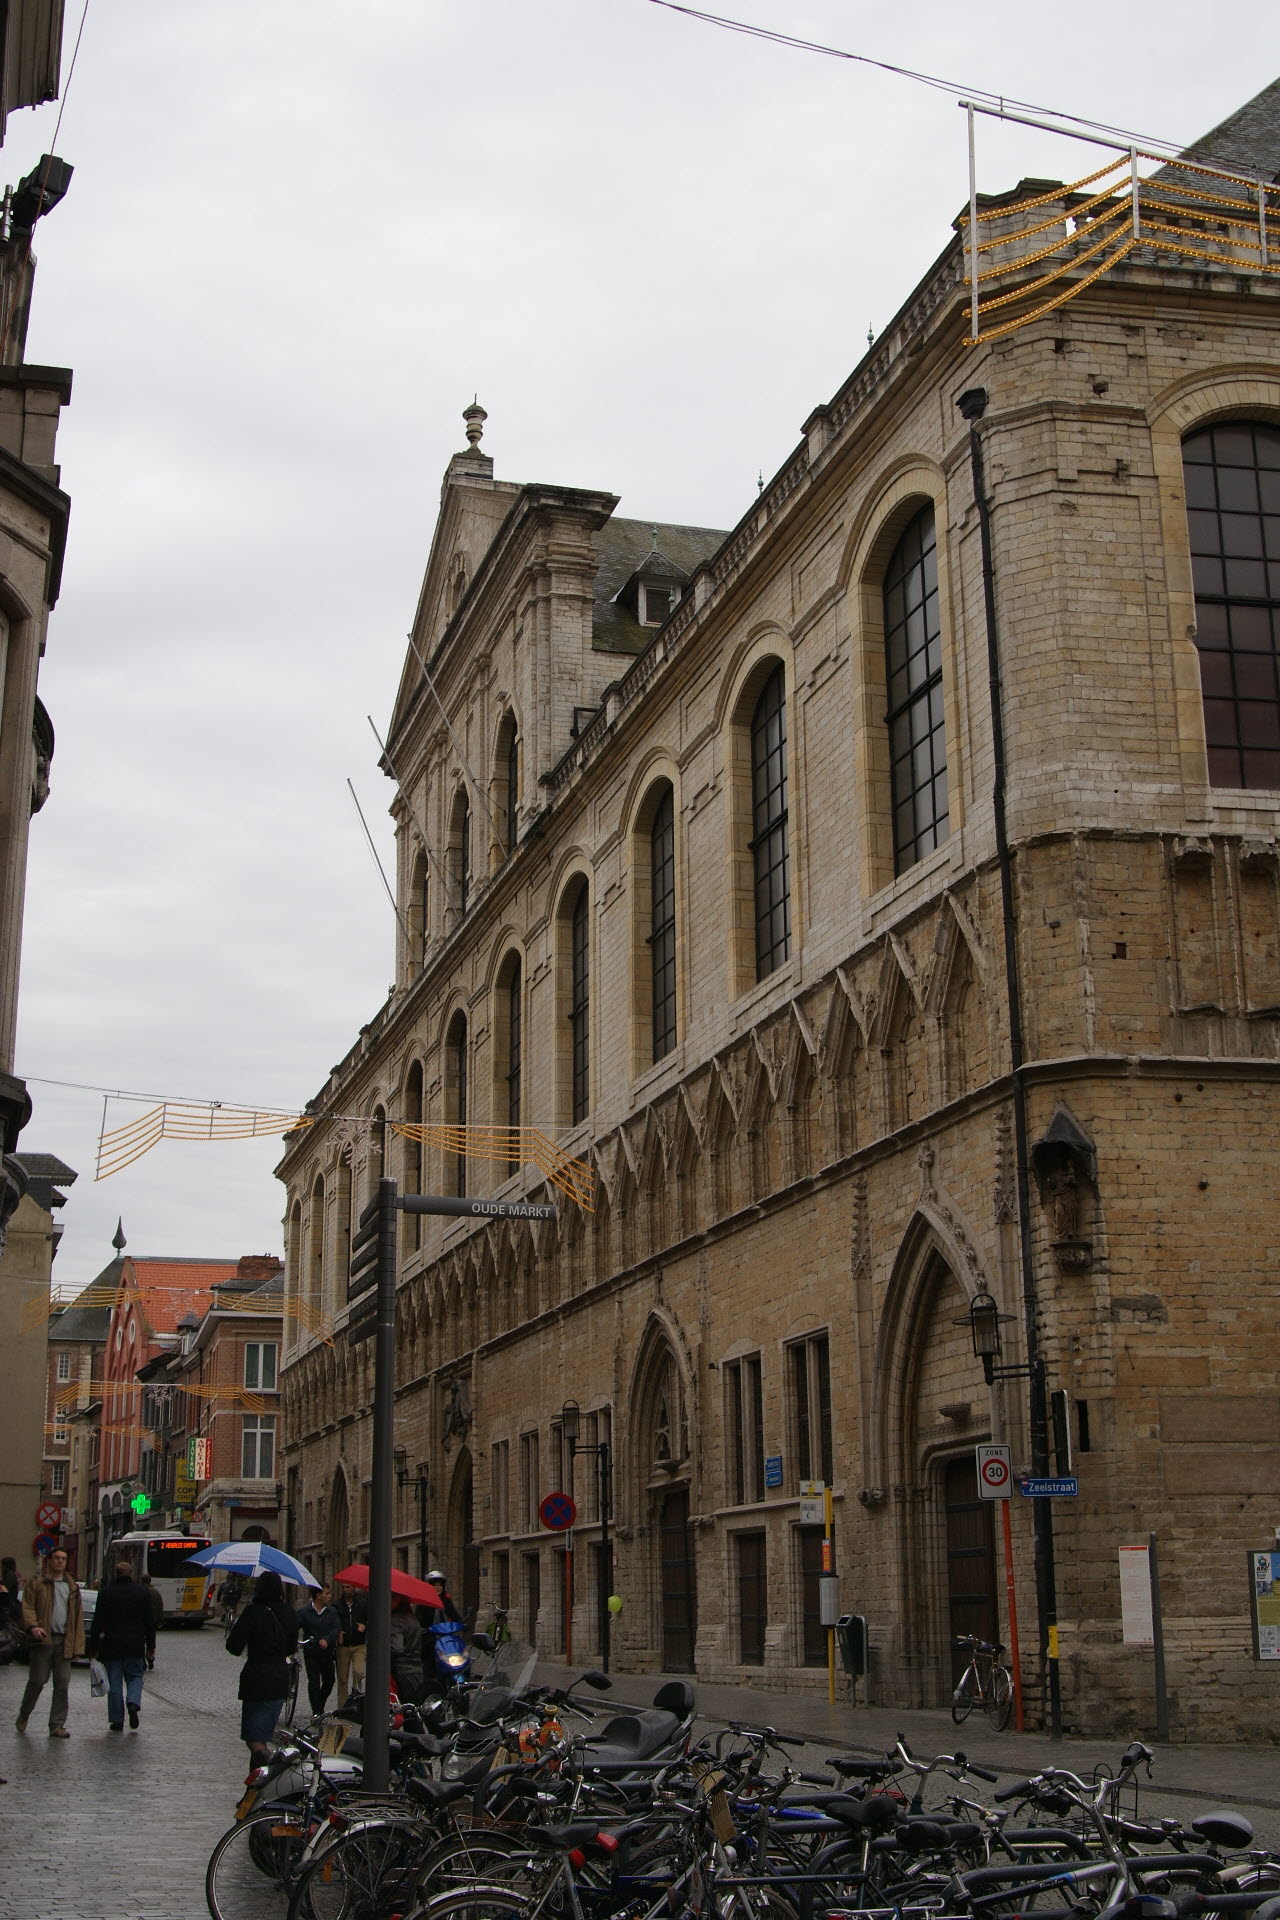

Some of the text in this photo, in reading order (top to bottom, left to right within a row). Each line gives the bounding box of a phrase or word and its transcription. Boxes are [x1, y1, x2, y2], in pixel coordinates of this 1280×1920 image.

[471, 1202, 551, 1218] OUDE MARKT
[988, 1467, 1003, 1478] 30
[1028, 1482, 1075, 1492] Zeelstraat
